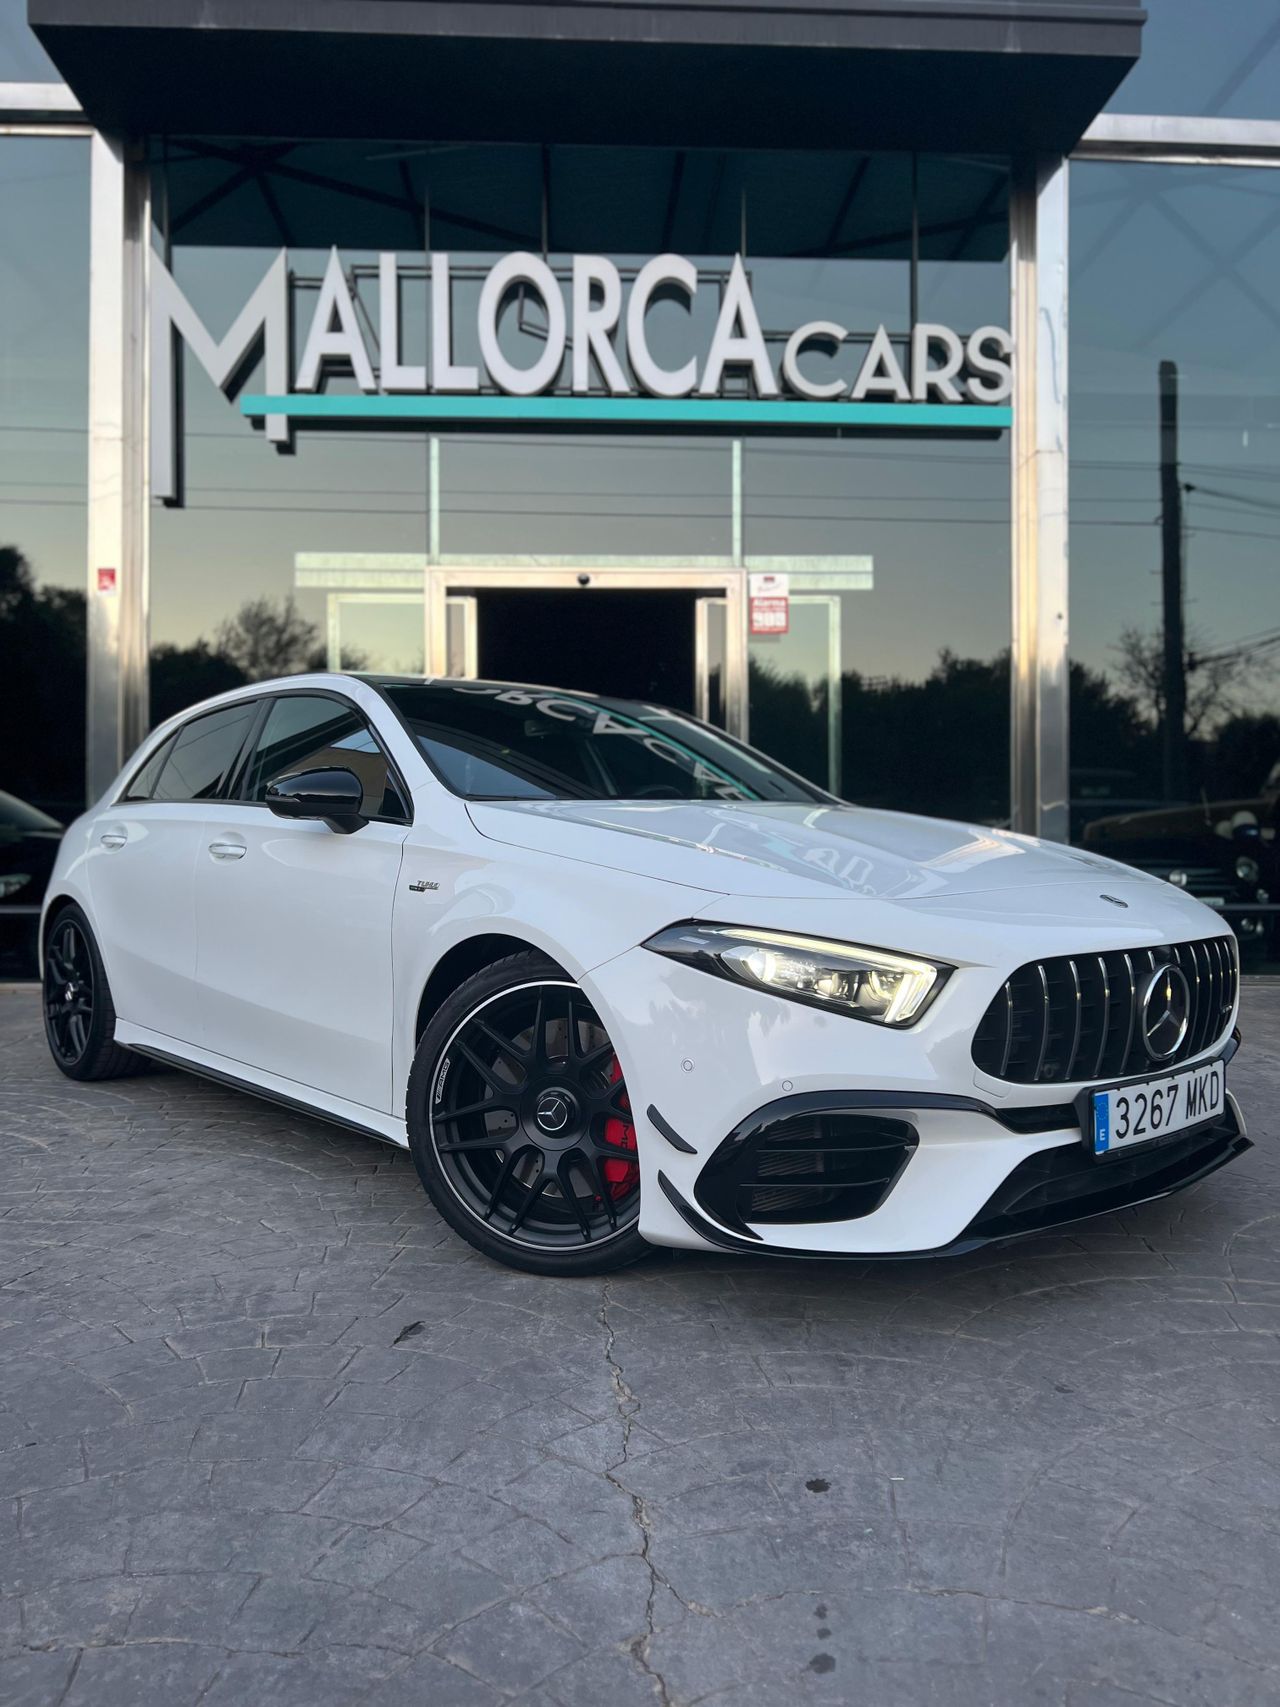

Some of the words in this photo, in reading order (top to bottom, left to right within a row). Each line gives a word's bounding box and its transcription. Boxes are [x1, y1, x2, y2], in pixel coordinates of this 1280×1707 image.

[150, 244, 779, 498] MALLORCA
[781, 320, 1014, 402] CARS
[1099, 1128, 1106, 1141] E
[1115, 1084, 1179, 1139] 3267
[1185, 1070, 1220, 1120] MKD
